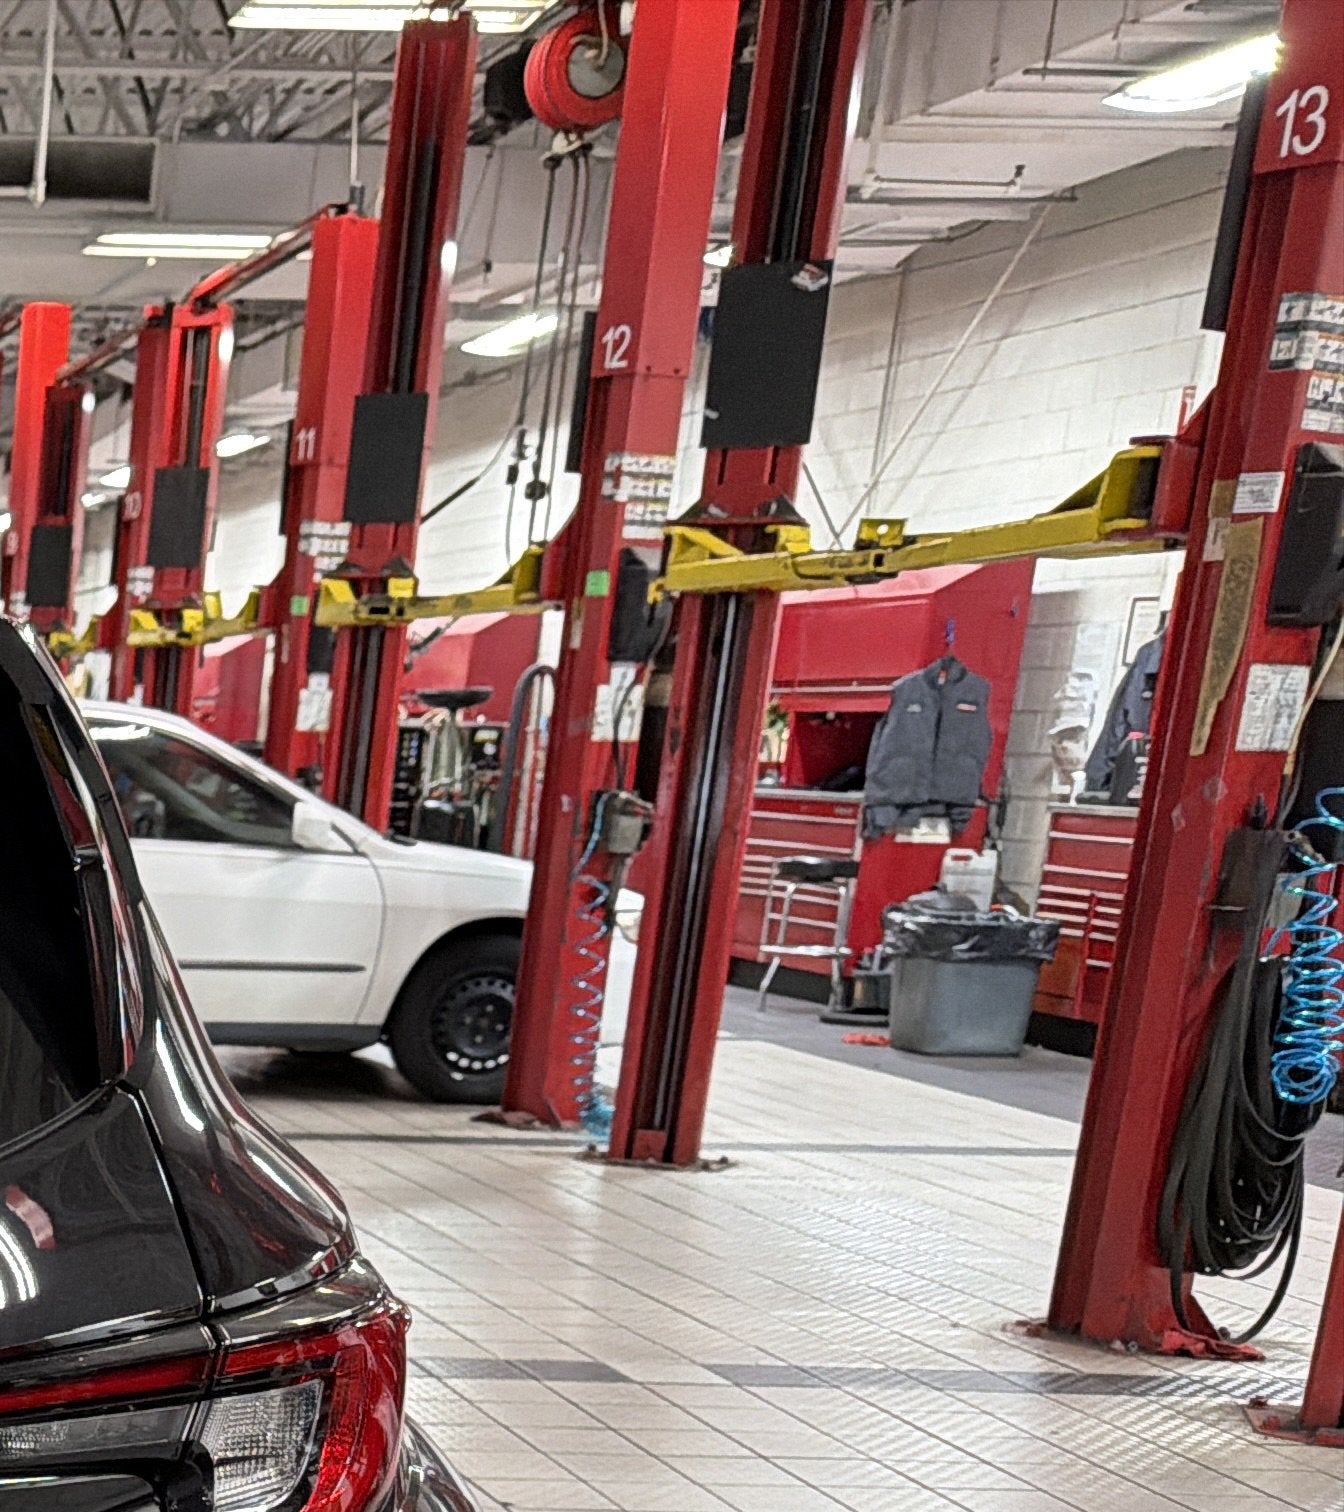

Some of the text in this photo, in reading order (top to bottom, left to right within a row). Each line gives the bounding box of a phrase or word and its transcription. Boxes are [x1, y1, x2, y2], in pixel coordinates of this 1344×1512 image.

[1275, 86, 1329, 158] 13
[601, 324, 631, 369] 12
[296, 427, 316, 462] 11
[124, 491, 142, 520] 10
